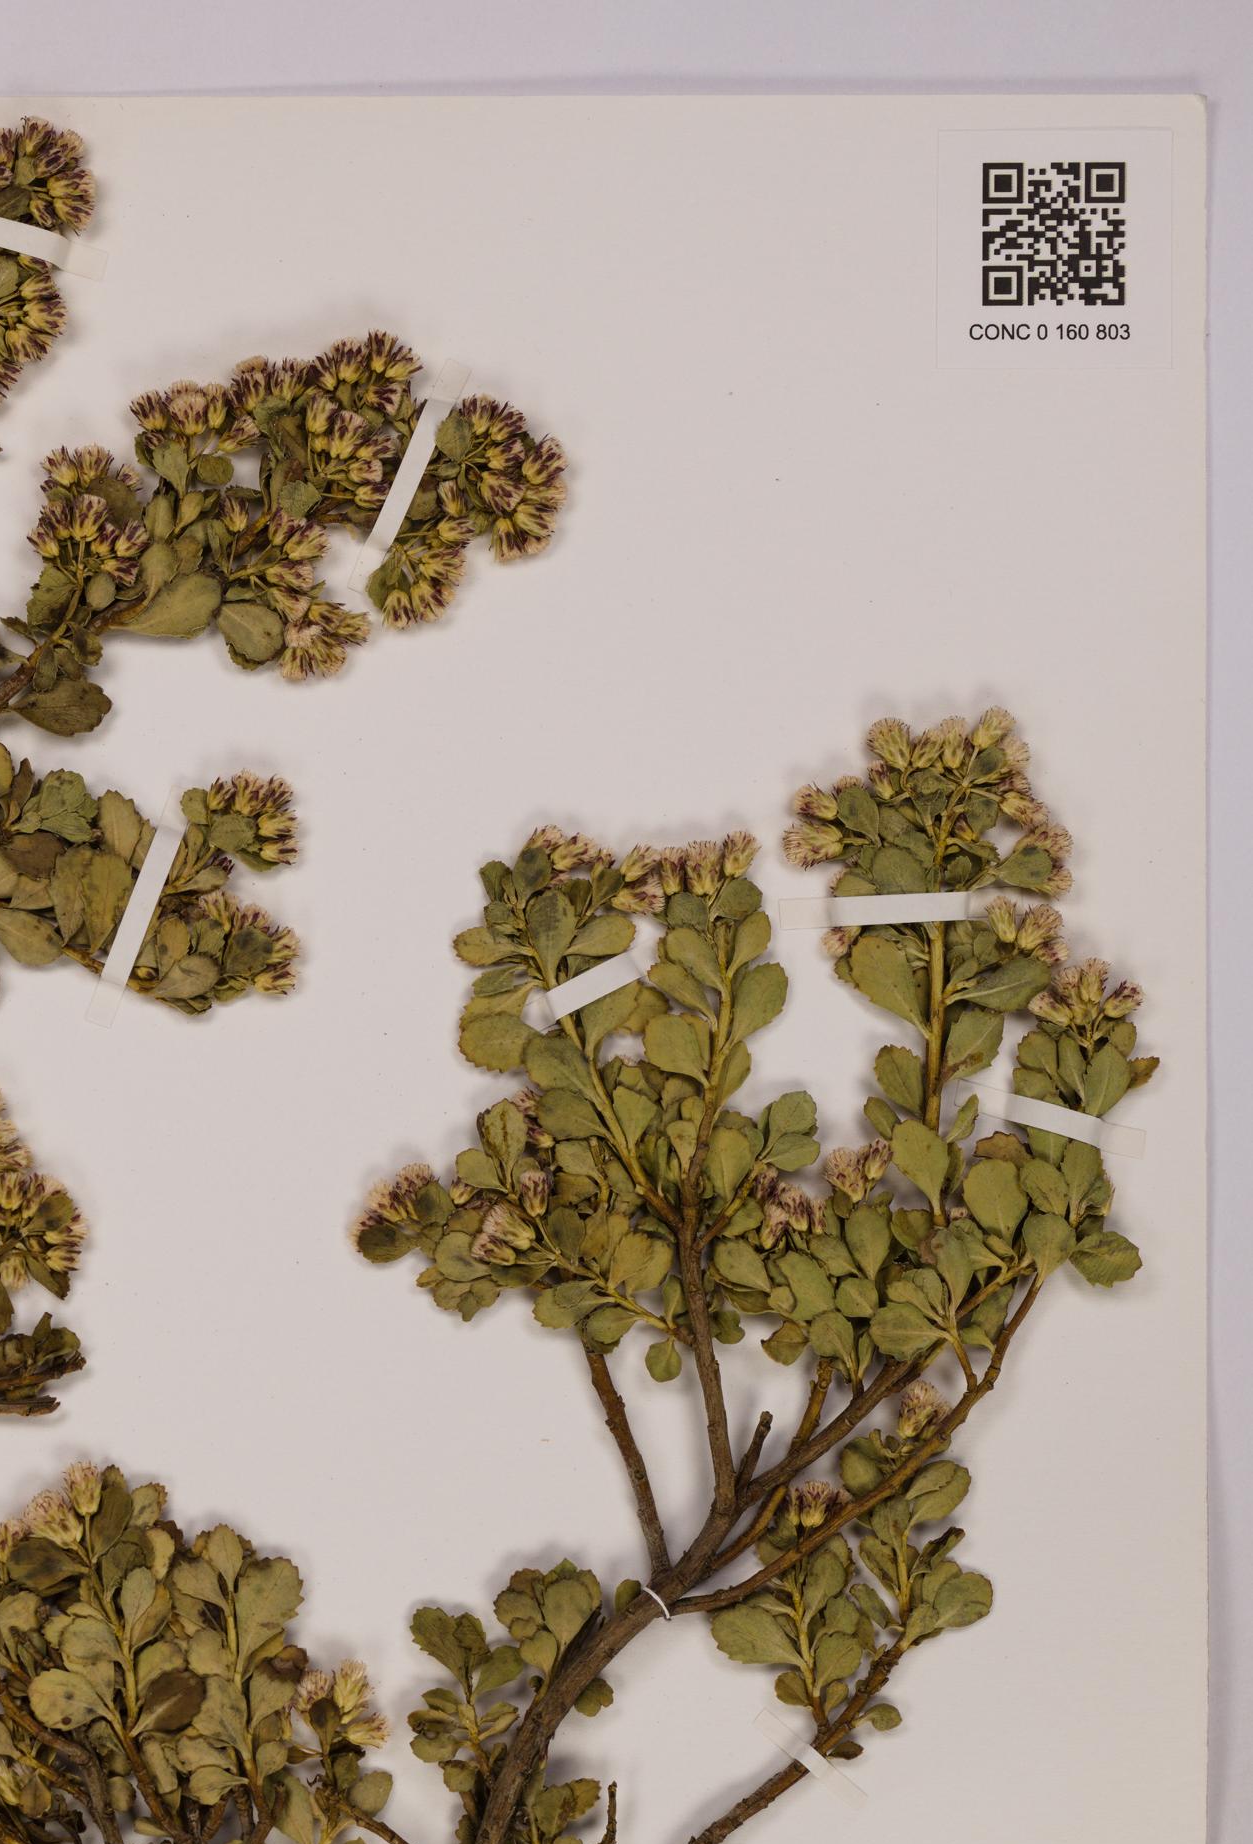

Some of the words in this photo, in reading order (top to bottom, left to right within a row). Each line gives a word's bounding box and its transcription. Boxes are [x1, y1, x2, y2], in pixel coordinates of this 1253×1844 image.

[968, 323, 1031, 341] CONC
[1036, 323, 1049, 341] 0
[1055, 323, 1090, 341] 160
[1095, 323, 1131, 341] 803
